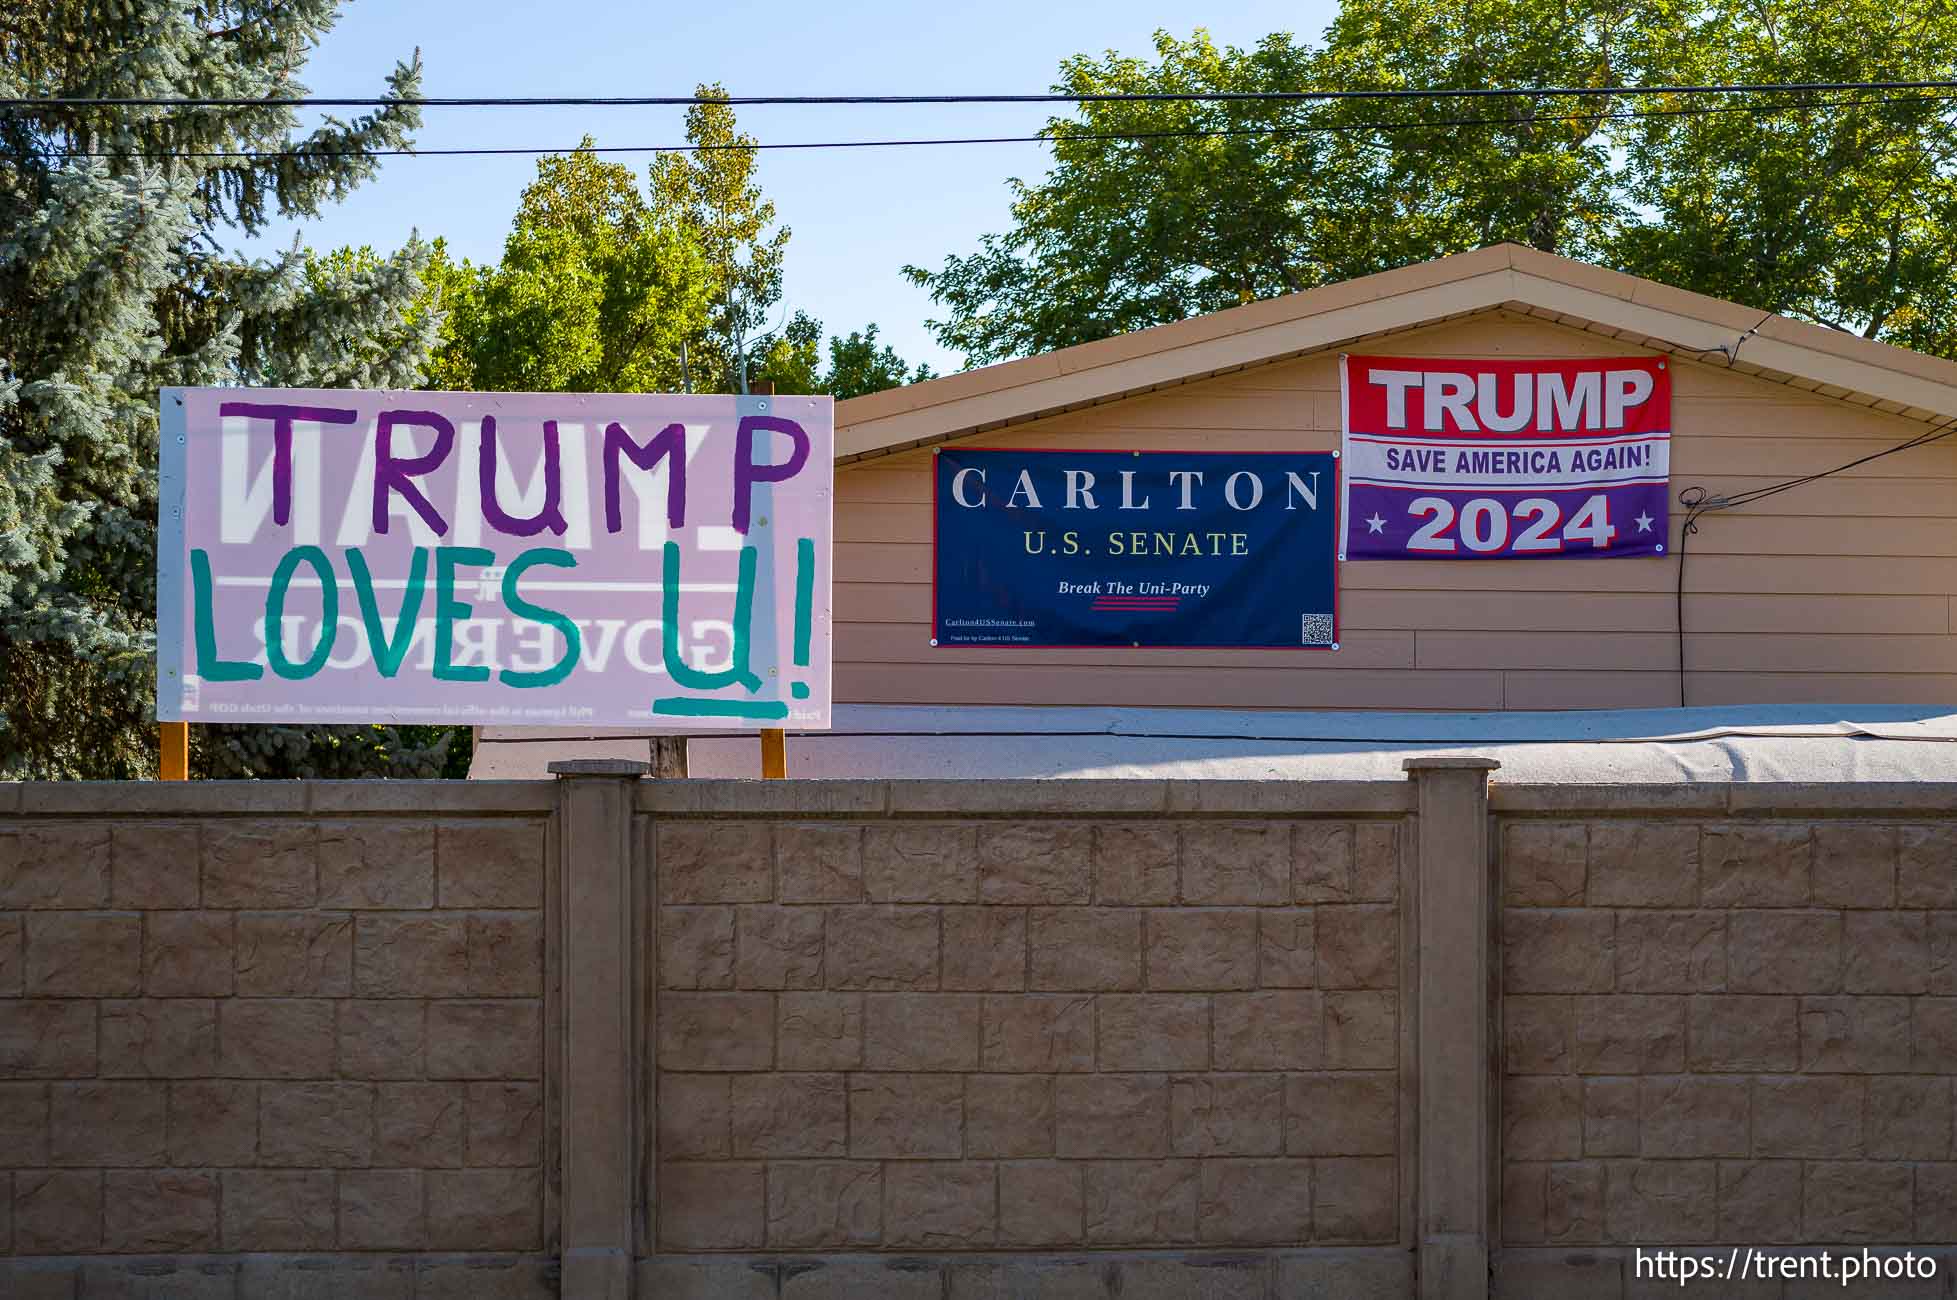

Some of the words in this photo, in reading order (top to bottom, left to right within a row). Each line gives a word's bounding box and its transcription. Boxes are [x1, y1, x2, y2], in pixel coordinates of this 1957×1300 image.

[1369, 369, 1654, 432] TRUMP
[219, 402, 810, 537] TRUMP
[1387, 447, 1446, 471] SAVE
[1456, 450, 1561, 474] AMERICA
[1571, 444, 1651, 472] AGAIN!
[952, 467, 1321, 511] CARLTON
[1023, 530, 1092, 556] U.S.
[1109, 532, 1249, 556] SENATE
[1407, 494, 1617, 552] 2024
[1058, 580, 1101, 595] Break
[1106, 581, 1133, 595] The
[1138, 582, 1211, 598] Uni-Party
[190, 545, 581, 688] LOVES
